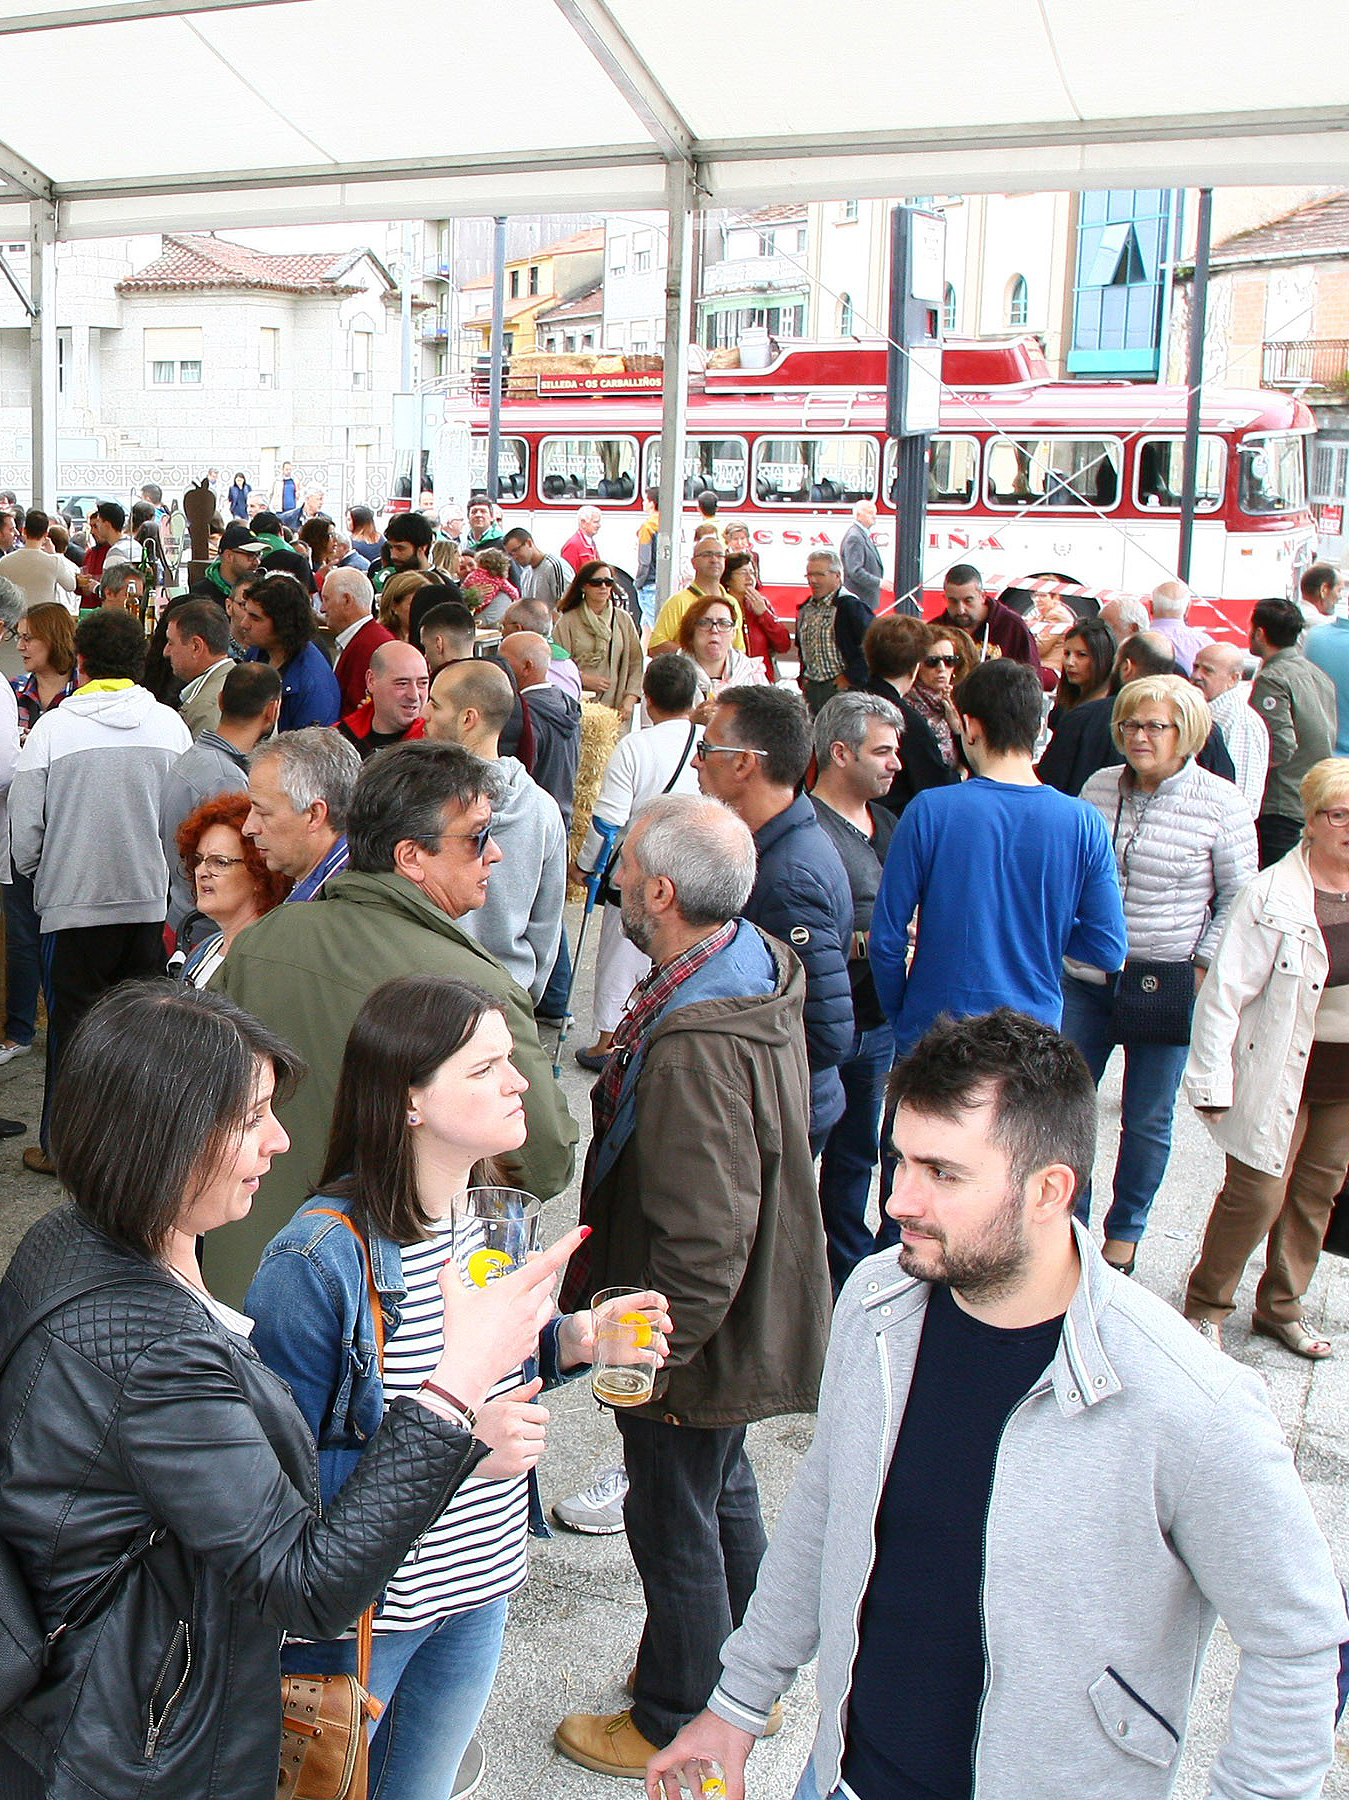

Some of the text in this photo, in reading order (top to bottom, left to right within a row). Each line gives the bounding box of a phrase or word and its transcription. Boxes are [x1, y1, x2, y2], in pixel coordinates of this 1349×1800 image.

[541, 380, 578, 389] SILLEDA
[585, 379, 598, 388] OS
[600, 376, 662, 388] CARBALLIÑOS
